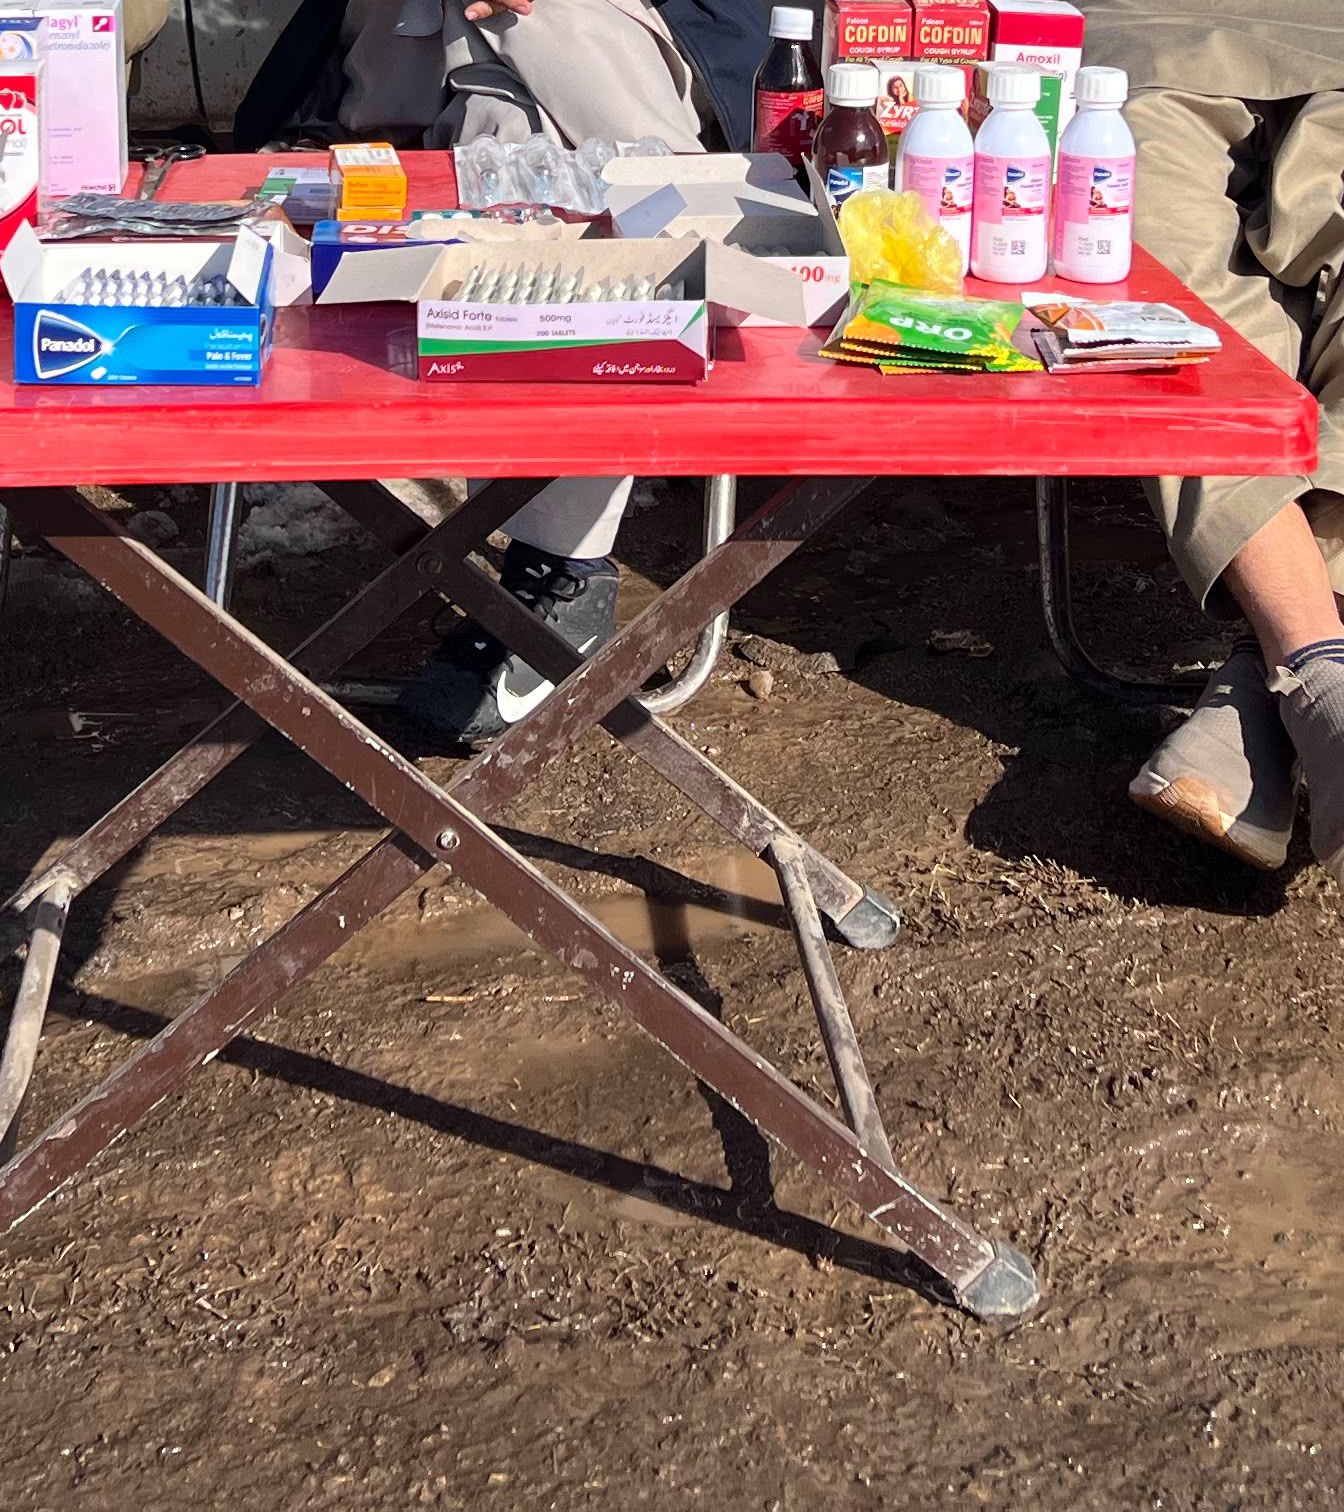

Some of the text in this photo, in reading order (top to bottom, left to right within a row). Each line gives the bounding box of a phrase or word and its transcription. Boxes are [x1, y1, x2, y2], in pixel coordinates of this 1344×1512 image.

[844, 25, 907, 44] COFDIN
[919, 26, 983, 45] COFDIN
[849, 46, 874, 54] COUGH
[951, 48, 977, 56] SYRUP
[1015, 52, 1061, 65] Amoxil
[341, 225, 408, 235] DIS
[426, 307, 461, 321] Axisid
[462, 309, 492, 321] Forte
[539, 313, 572, 324] 500mg
[551, 329, 577, 337] TABLETS
[41, 338, 95, 352] Panadol
[206, 352, 253, 360] Pain & Fever
